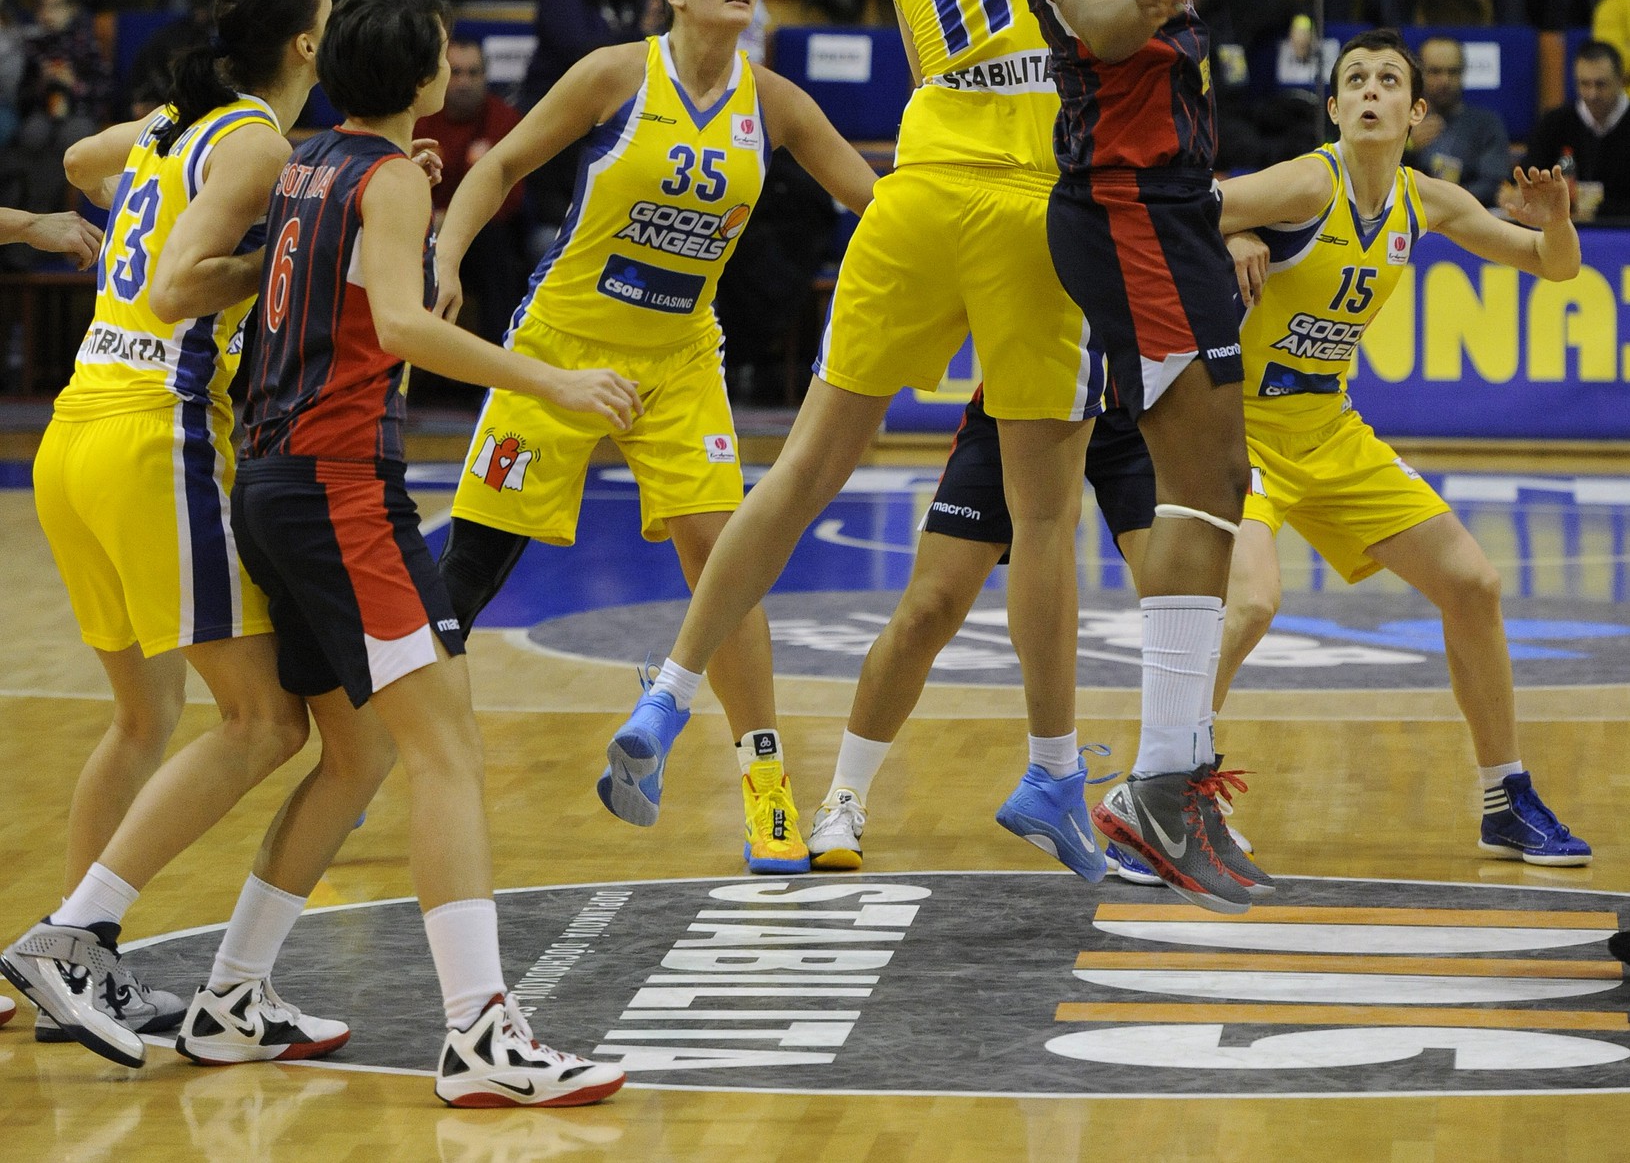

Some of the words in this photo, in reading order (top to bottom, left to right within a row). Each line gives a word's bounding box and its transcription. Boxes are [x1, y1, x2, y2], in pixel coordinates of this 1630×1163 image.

[660, 142, 728, 204] 35
[629, 201, 722, 237] GOOD
[617, 222, 728, 261] ANGELS
[267, 217, 300, 334] 6
[1328, 265, 1378, 315] 15
[650, 292, 694, 309] LEASING
[1289, 312, 1364, 342] GOOD
[933, 501, 981, 521] macron
[592, 882, 932, 1072] STABILITA
